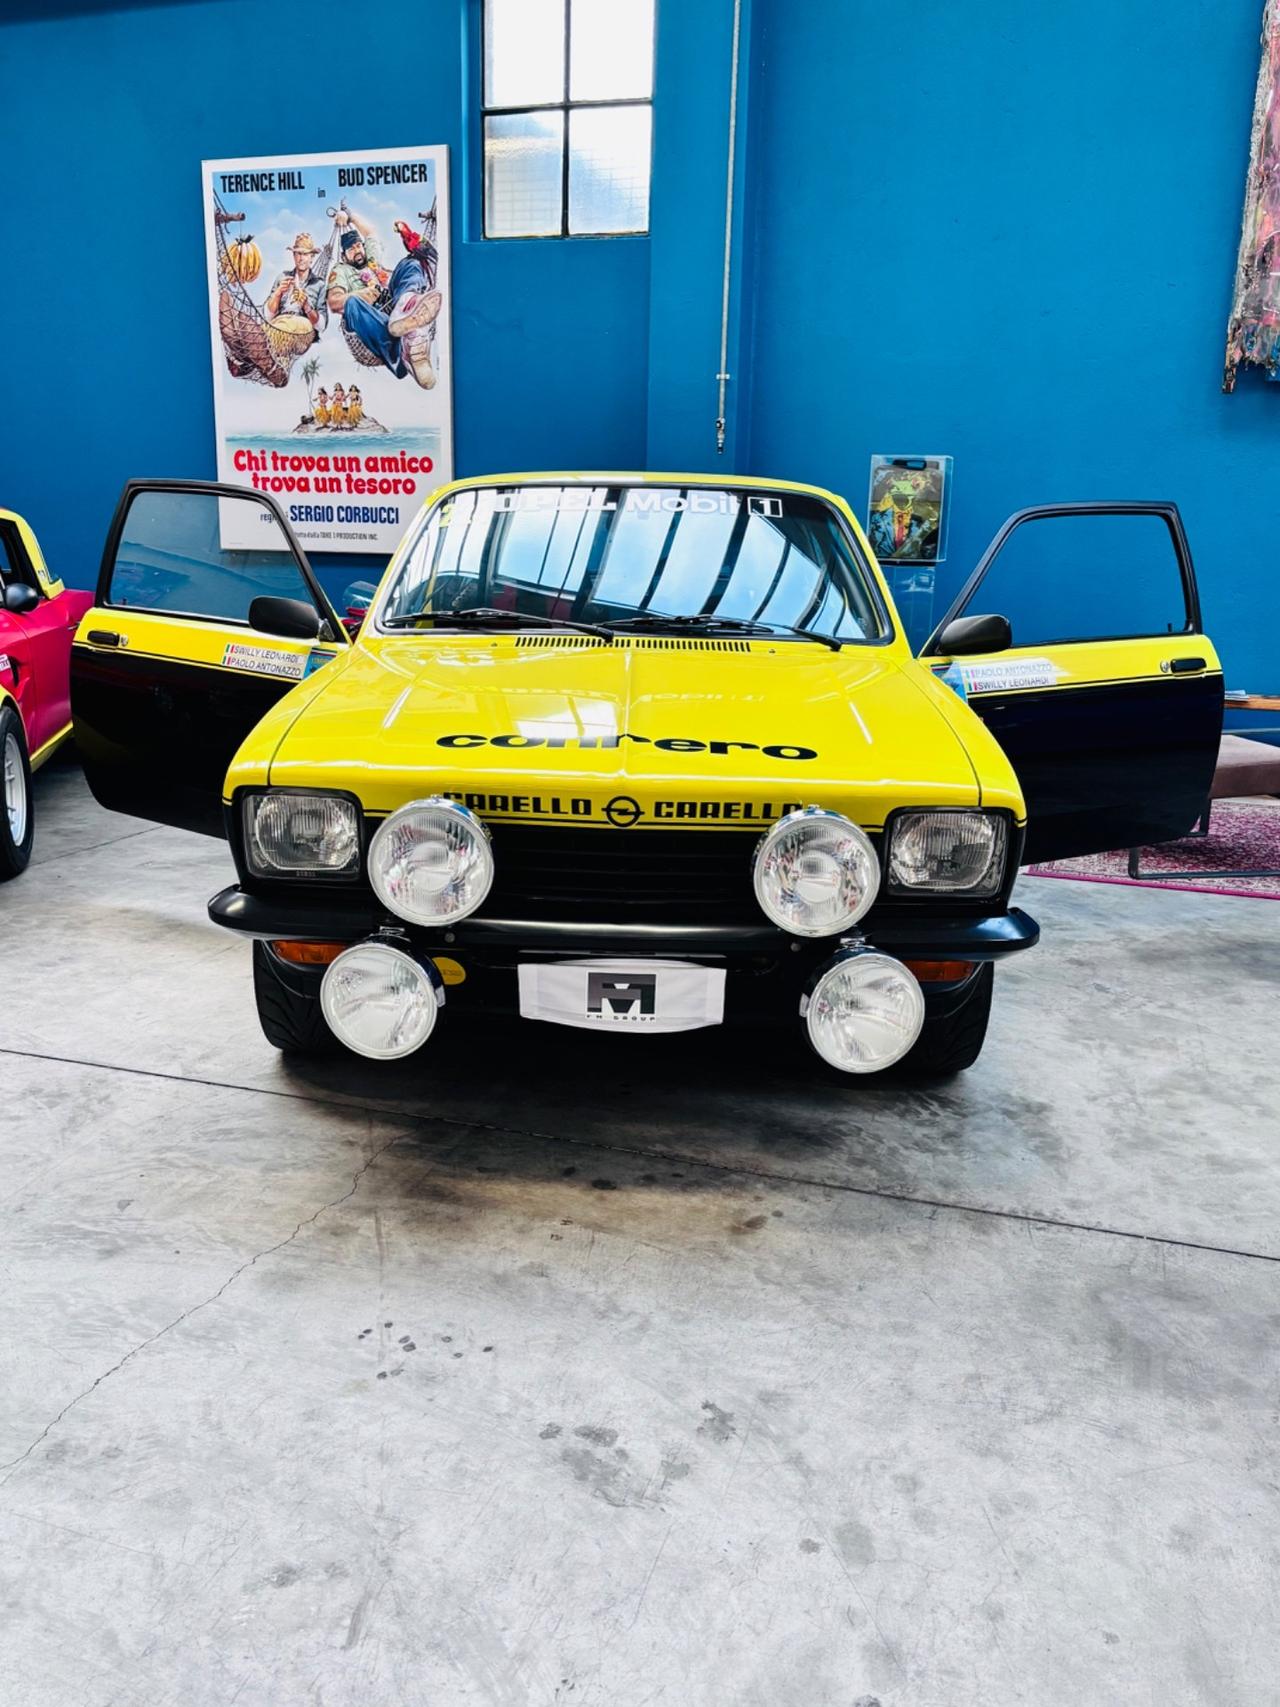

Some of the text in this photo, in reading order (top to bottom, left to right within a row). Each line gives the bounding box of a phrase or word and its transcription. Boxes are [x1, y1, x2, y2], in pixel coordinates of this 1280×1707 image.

[220, 171, 305, 193] TERENCE HILL
[338, 163, 428, 187] BUD SPENCER
[317, 187, 326, 198] in
[234, 449, 433, 473] Chi trova un amico
[252, 472, 416, 495] trova un tesoro
[290, 505, 334, 523] SERGIO
[336, 505, 399, 524] CORBUCCI
[626, 493, 740, 515] Mobil
[231, 657, 301, 676] PAOLO ANTONAZZO
[261, 650, 299, 664] LEONARDI
